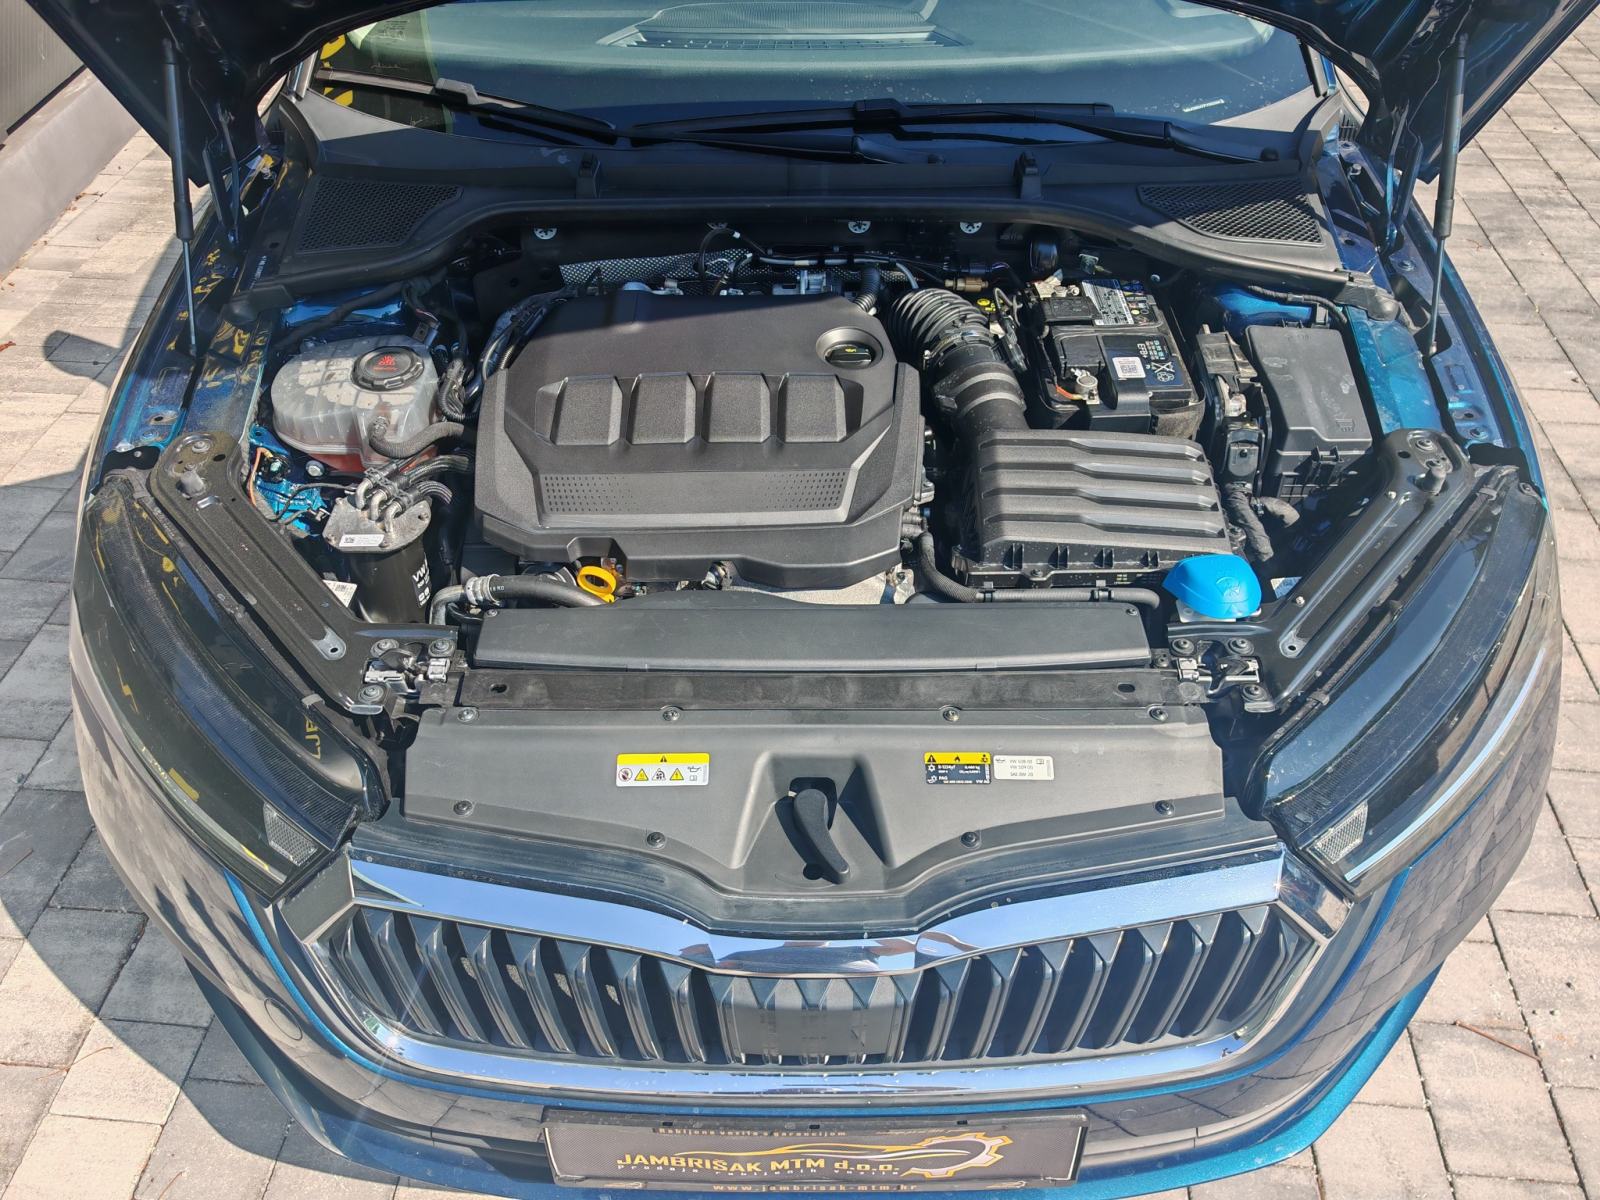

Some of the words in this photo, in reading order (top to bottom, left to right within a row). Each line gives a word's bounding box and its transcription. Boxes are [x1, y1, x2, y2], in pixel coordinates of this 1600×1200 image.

[616, 1153, 762, 1172] JAMBRIŠAK
[770, 1158, 825, 1171] MTM
[834, 1160, 899, 1171] d.o.o.
[713, 1184, 917, 1192] www.jambrisak-mtm.hr
